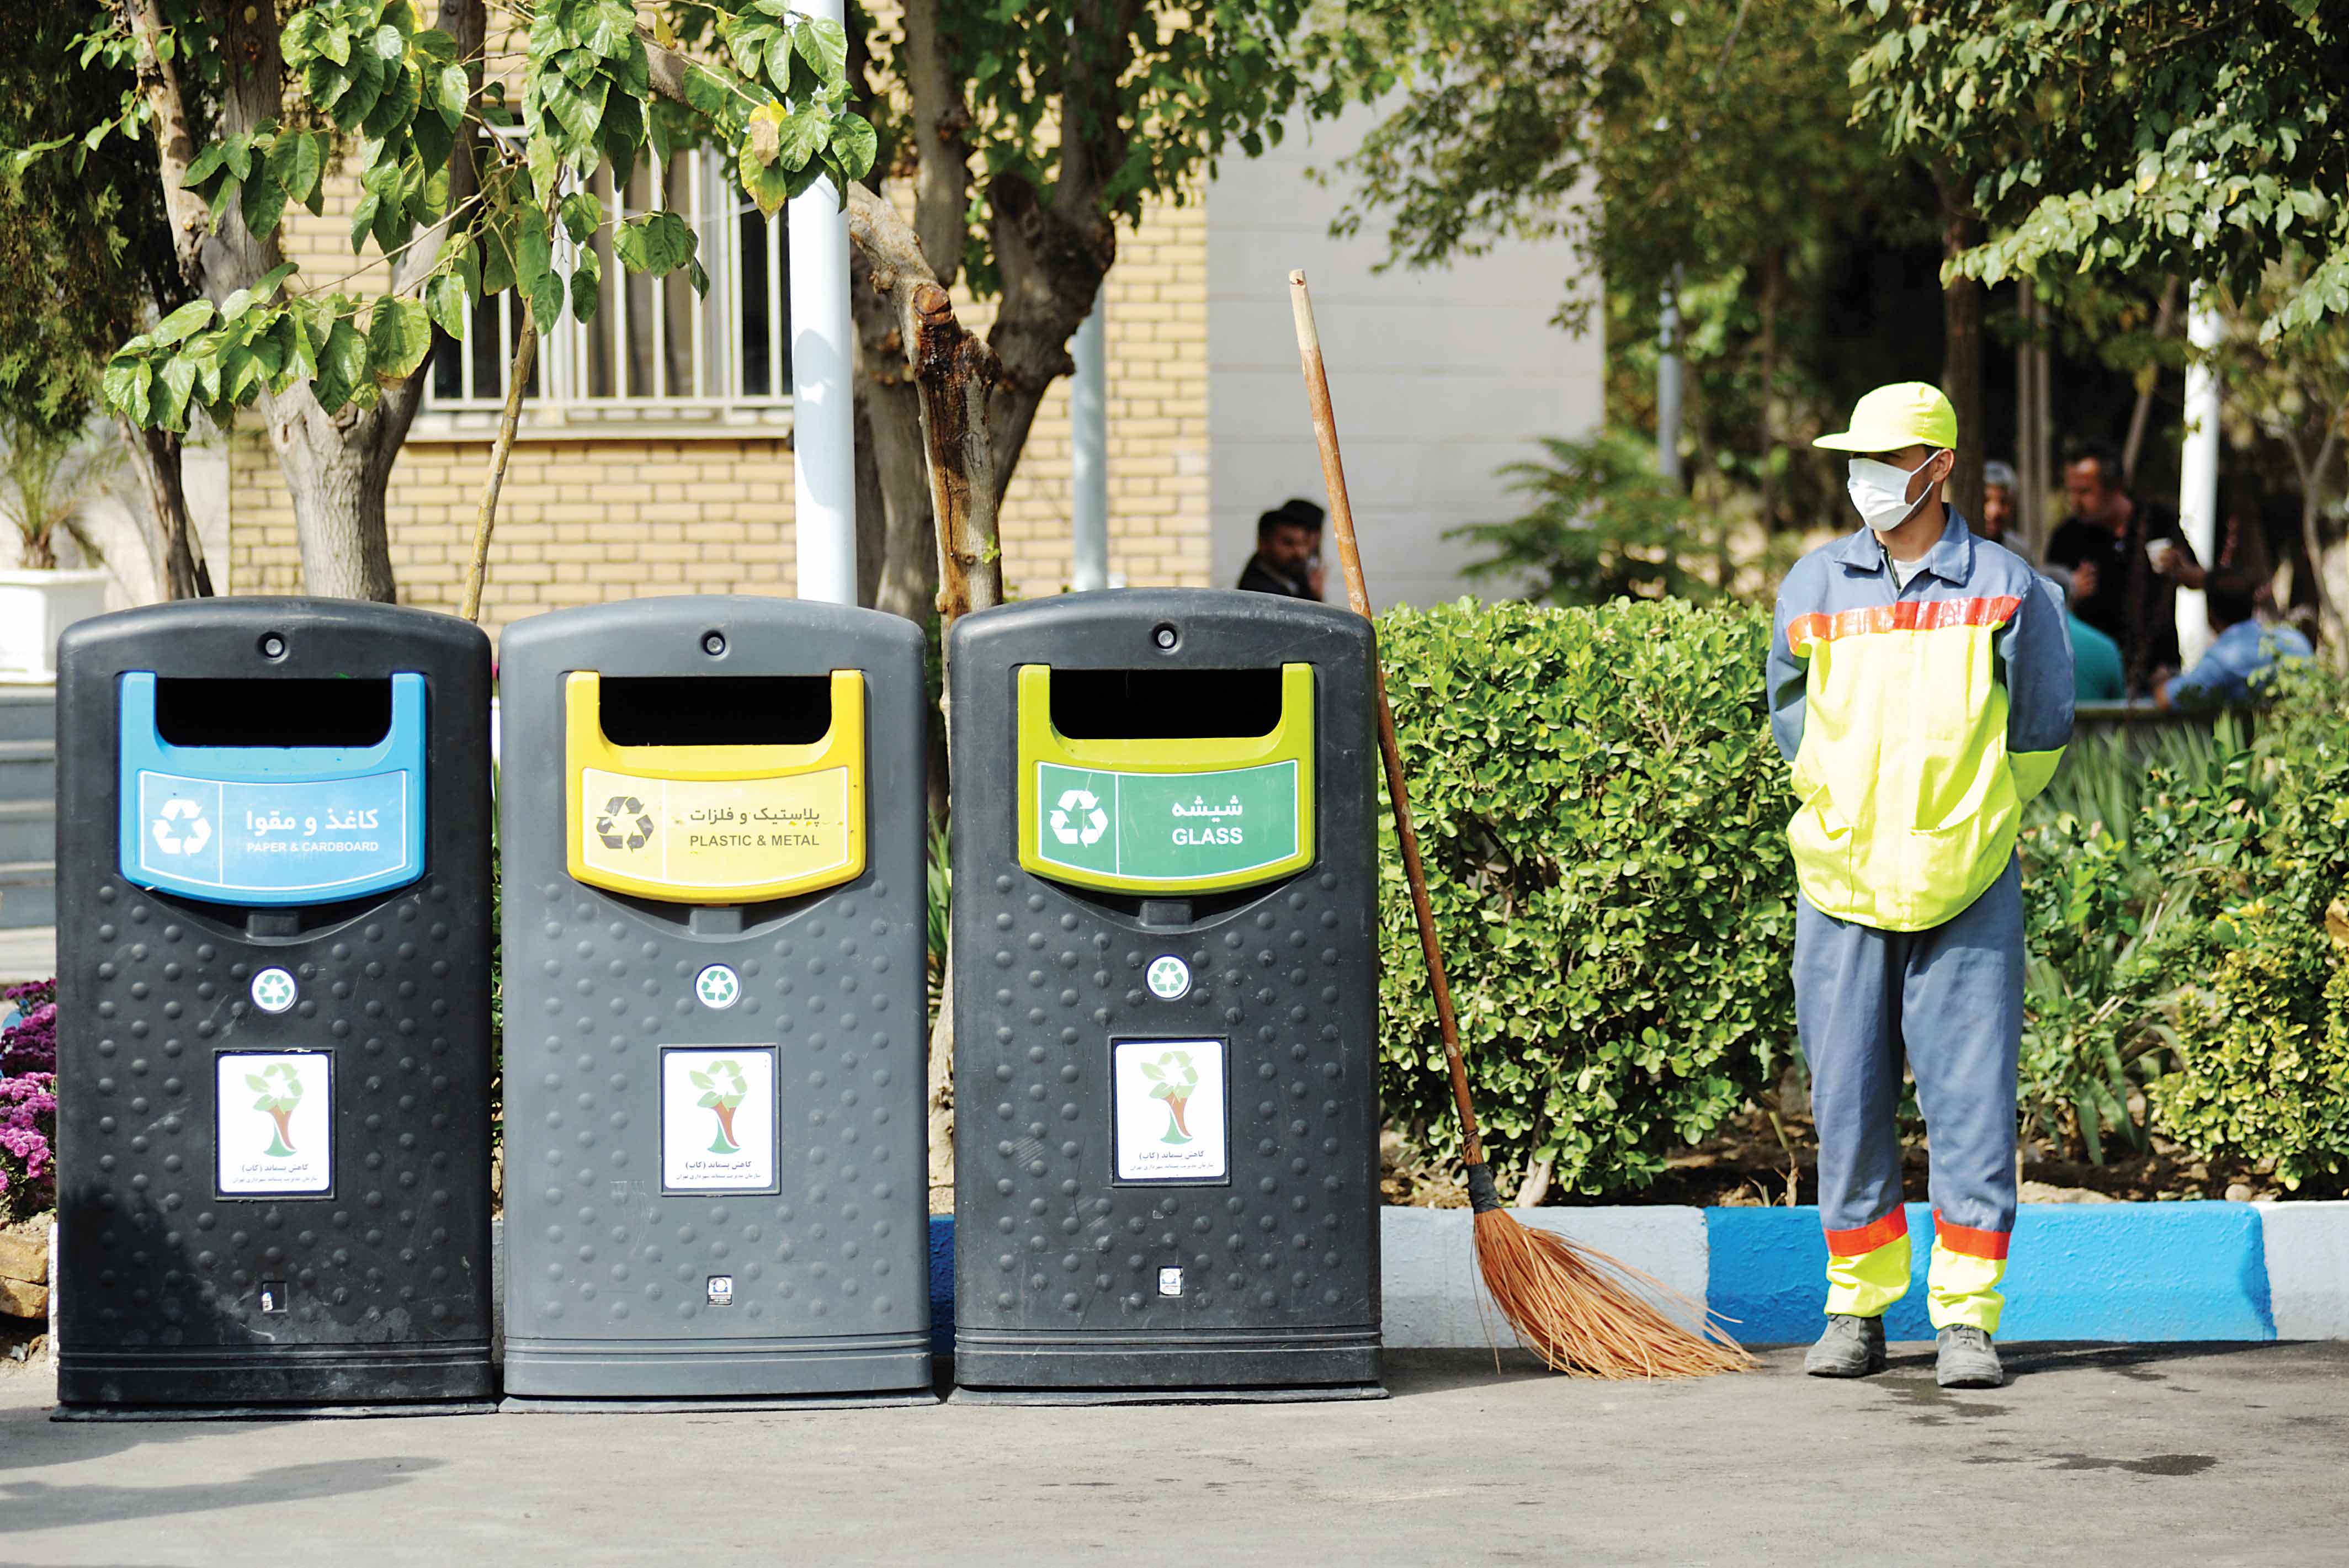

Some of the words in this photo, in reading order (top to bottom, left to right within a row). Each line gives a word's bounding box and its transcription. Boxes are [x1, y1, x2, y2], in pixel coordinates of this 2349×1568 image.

[689, 807, 734, 825] فلزات
[753, 807, 821, 827] پلاستیک
[1172, 795, 1243, 822] شیشه
[246, 810, 296, 837] مقوا
[304, 817, 317, 836] و
[325, 807, 379, 830] کاغذ
[740, 813, 748, 825] و
[690, 835, 752, 847] PLASTIC
[756, 835, 767, 847] &
[772, 835, 820, 846] METAL
[1172, 827, 1243, 846] GLASS
[246, 842, 286, 853] PAPER
[290, 842, 299, 852] &
[301, 841, 379, 853] CARDBOARD
